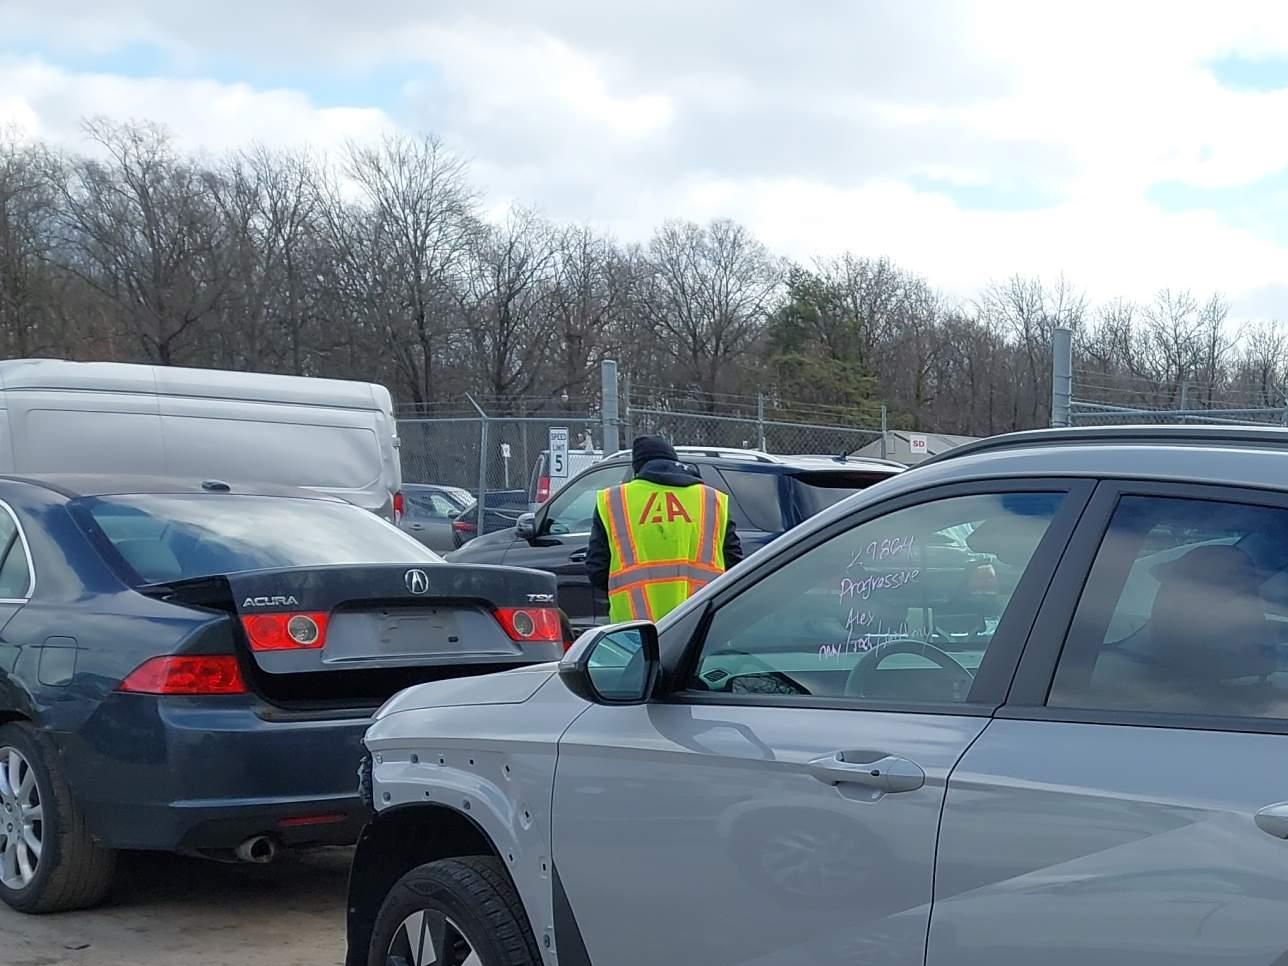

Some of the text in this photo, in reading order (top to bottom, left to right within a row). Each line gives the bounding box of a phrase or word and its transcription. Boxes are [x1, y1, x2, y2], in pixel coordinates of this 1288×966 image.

[912, 440, 925, 448] SD
[555, 454, 563, 473] 5
[840, 569, 919, 604] Progressive
[242, 596, 299, 607] ACURA
[527, 594, 554, 602] TSX
